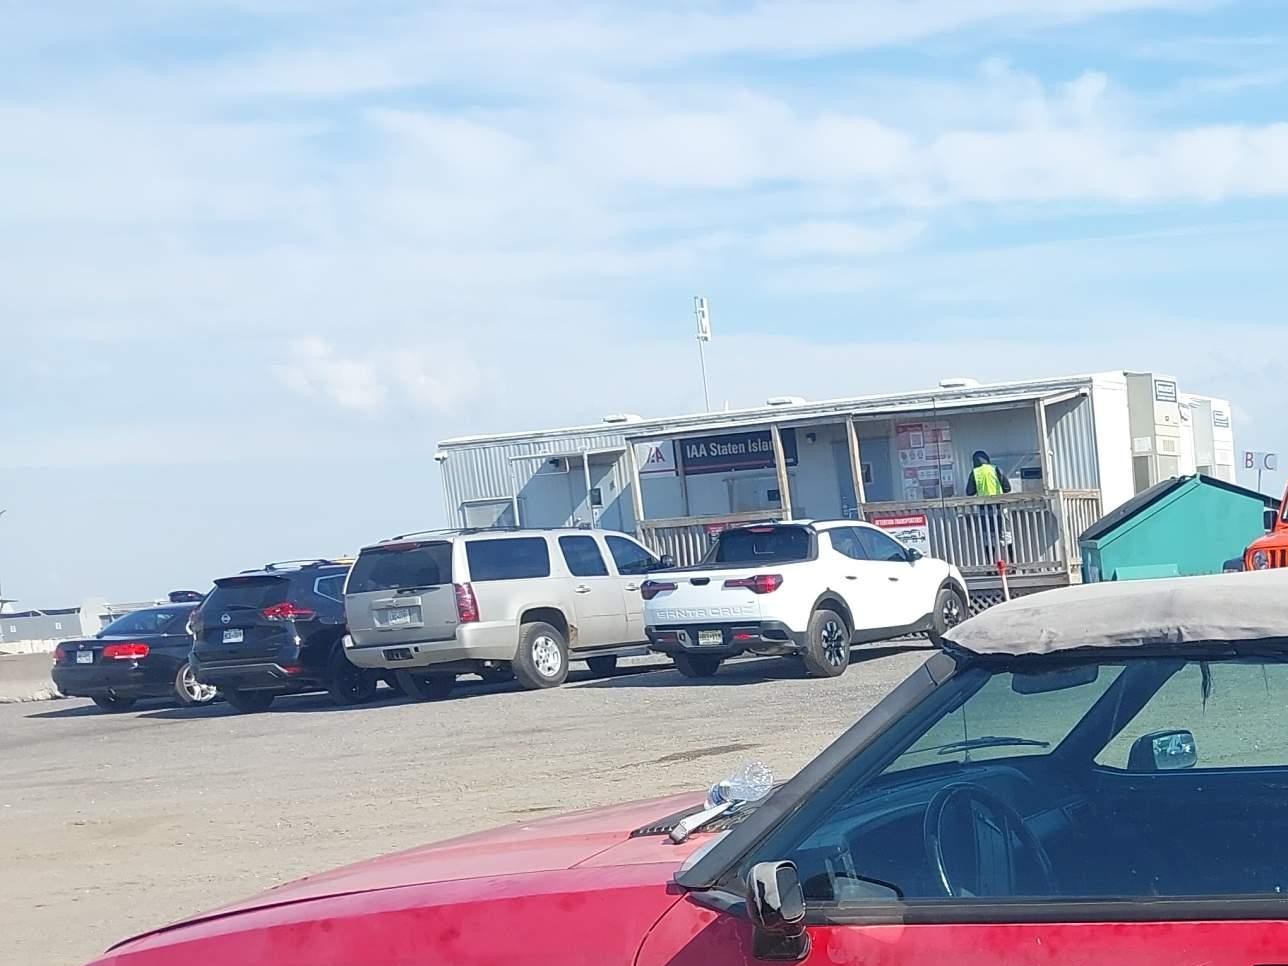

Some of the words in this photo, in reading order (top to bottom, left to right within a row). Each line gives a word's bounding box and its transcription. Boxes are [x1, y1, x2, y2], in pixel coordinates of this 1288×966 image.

[687, 443, 708, 460] IAA
[709, 441, 746, 458] Staten
[1245, 451, 1254, 469] B
[1263, 453, 1276, 470] C
